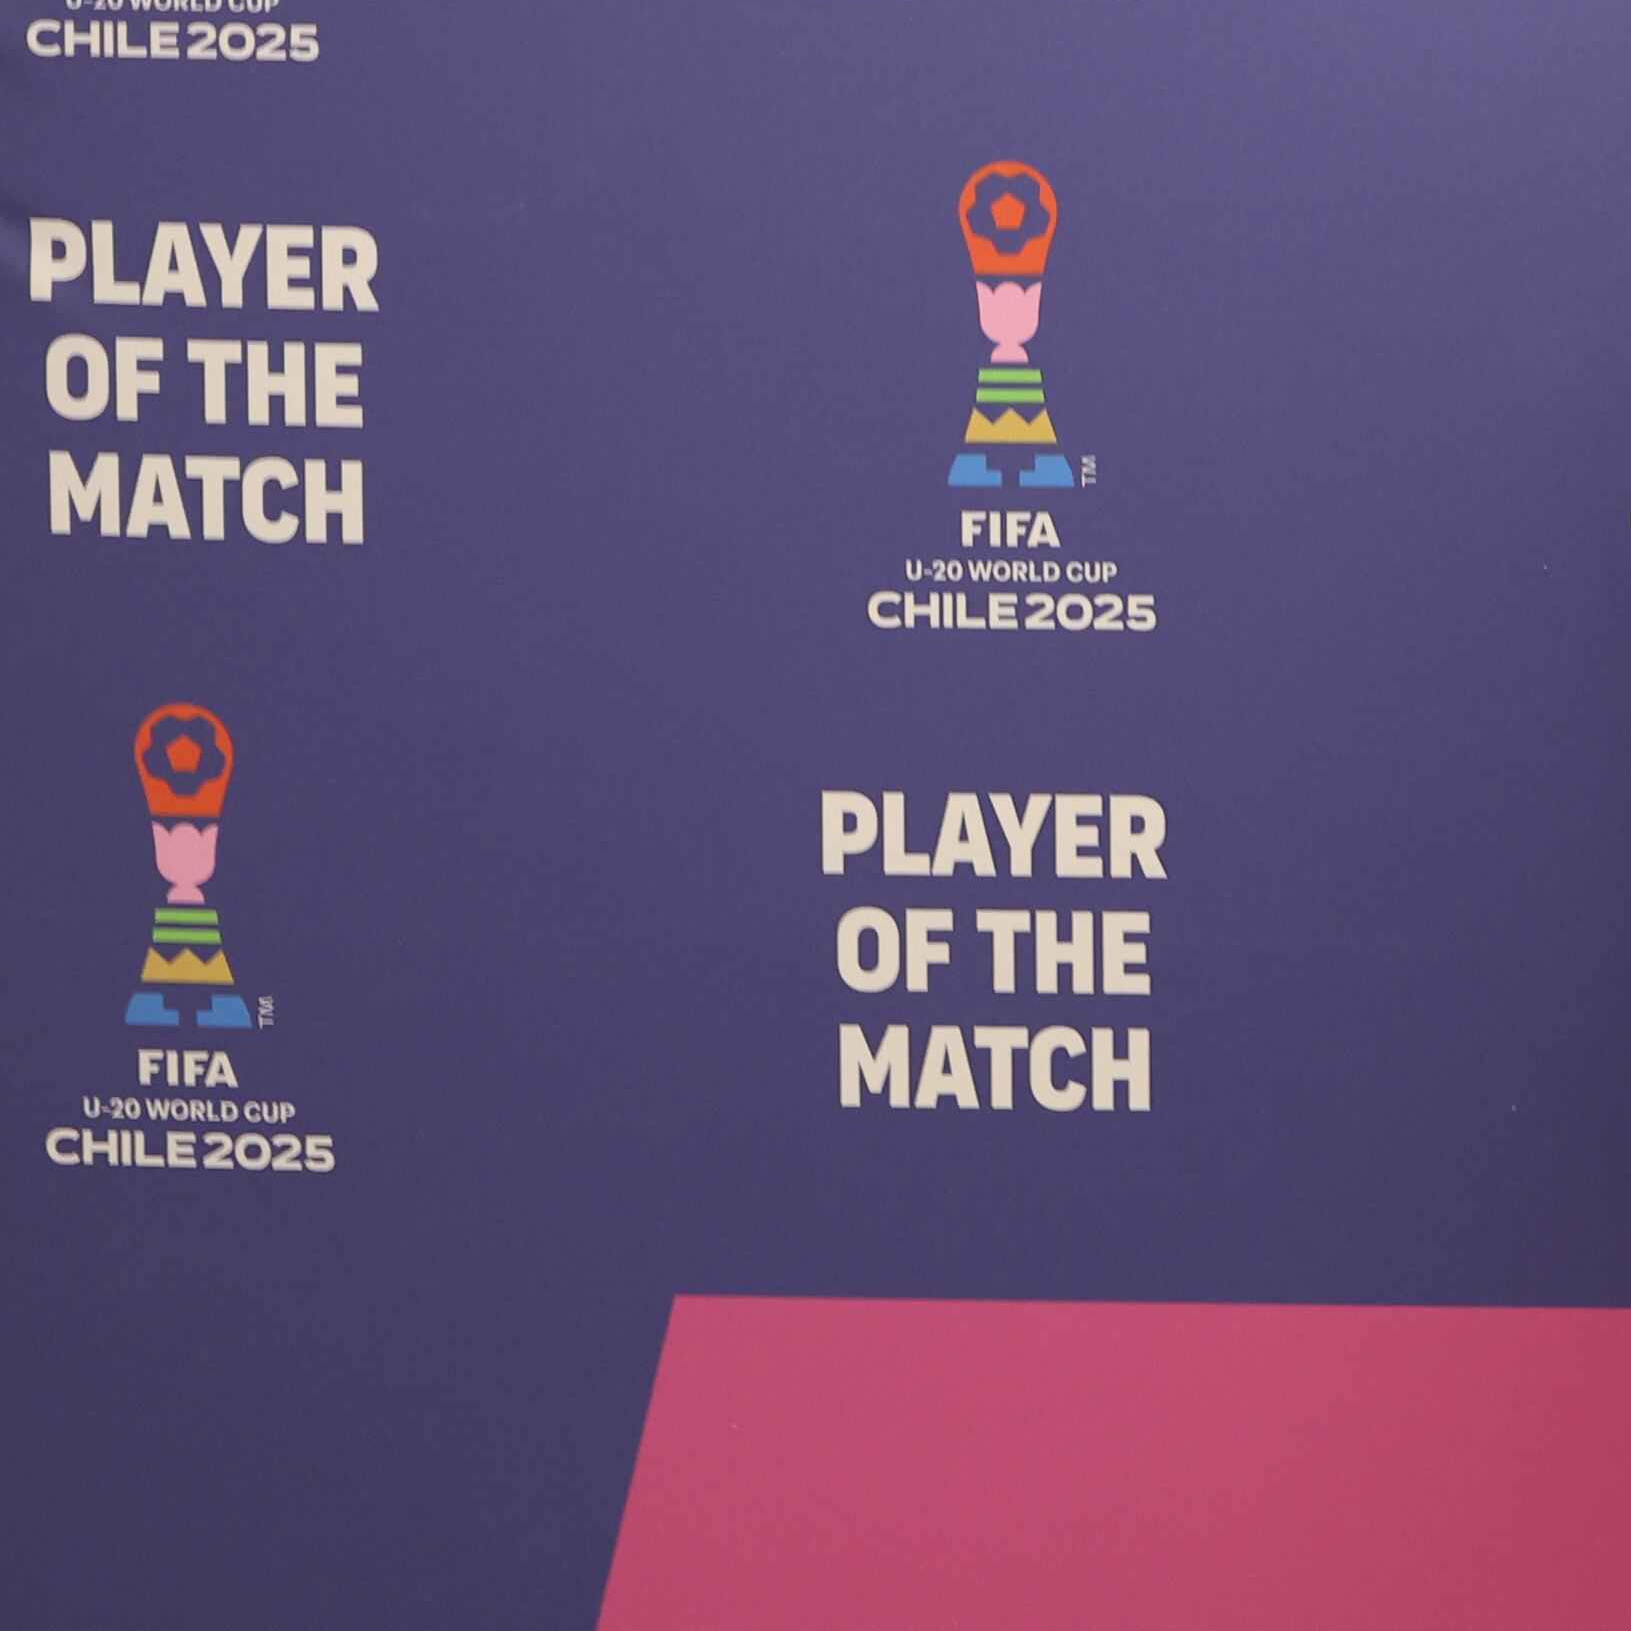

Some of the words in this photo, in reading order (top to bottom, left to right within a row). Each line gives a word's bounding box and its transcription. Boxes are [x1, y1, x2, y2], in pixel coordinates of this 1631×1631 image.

[29, 217, 380, 312] PLAYER
[45, 333, 164, 422] OF
[186, 339, 364, 429] THE
[49, 450, 364, 545] MATCH
[961, 510, 1061, 548] FIFA
[905, 559, 963, 582] U-20
[967, 559, 1061, 583] WORLD
[1066, 560, 1118, 583] CUP
[821, 790, 1168, 879] PLAYER
[836, 906, 954, 993] OF
[975, 909, 1151, 996] THE
[83, 1096, 142, 1120] U-20
[145, 1098, 239, 1122] WORLD
[243, 1101, 296, 1124] CUP
[138, 1048, 239, 1088] FIFA
[839, 1023, 1151, 1112] MATCH
